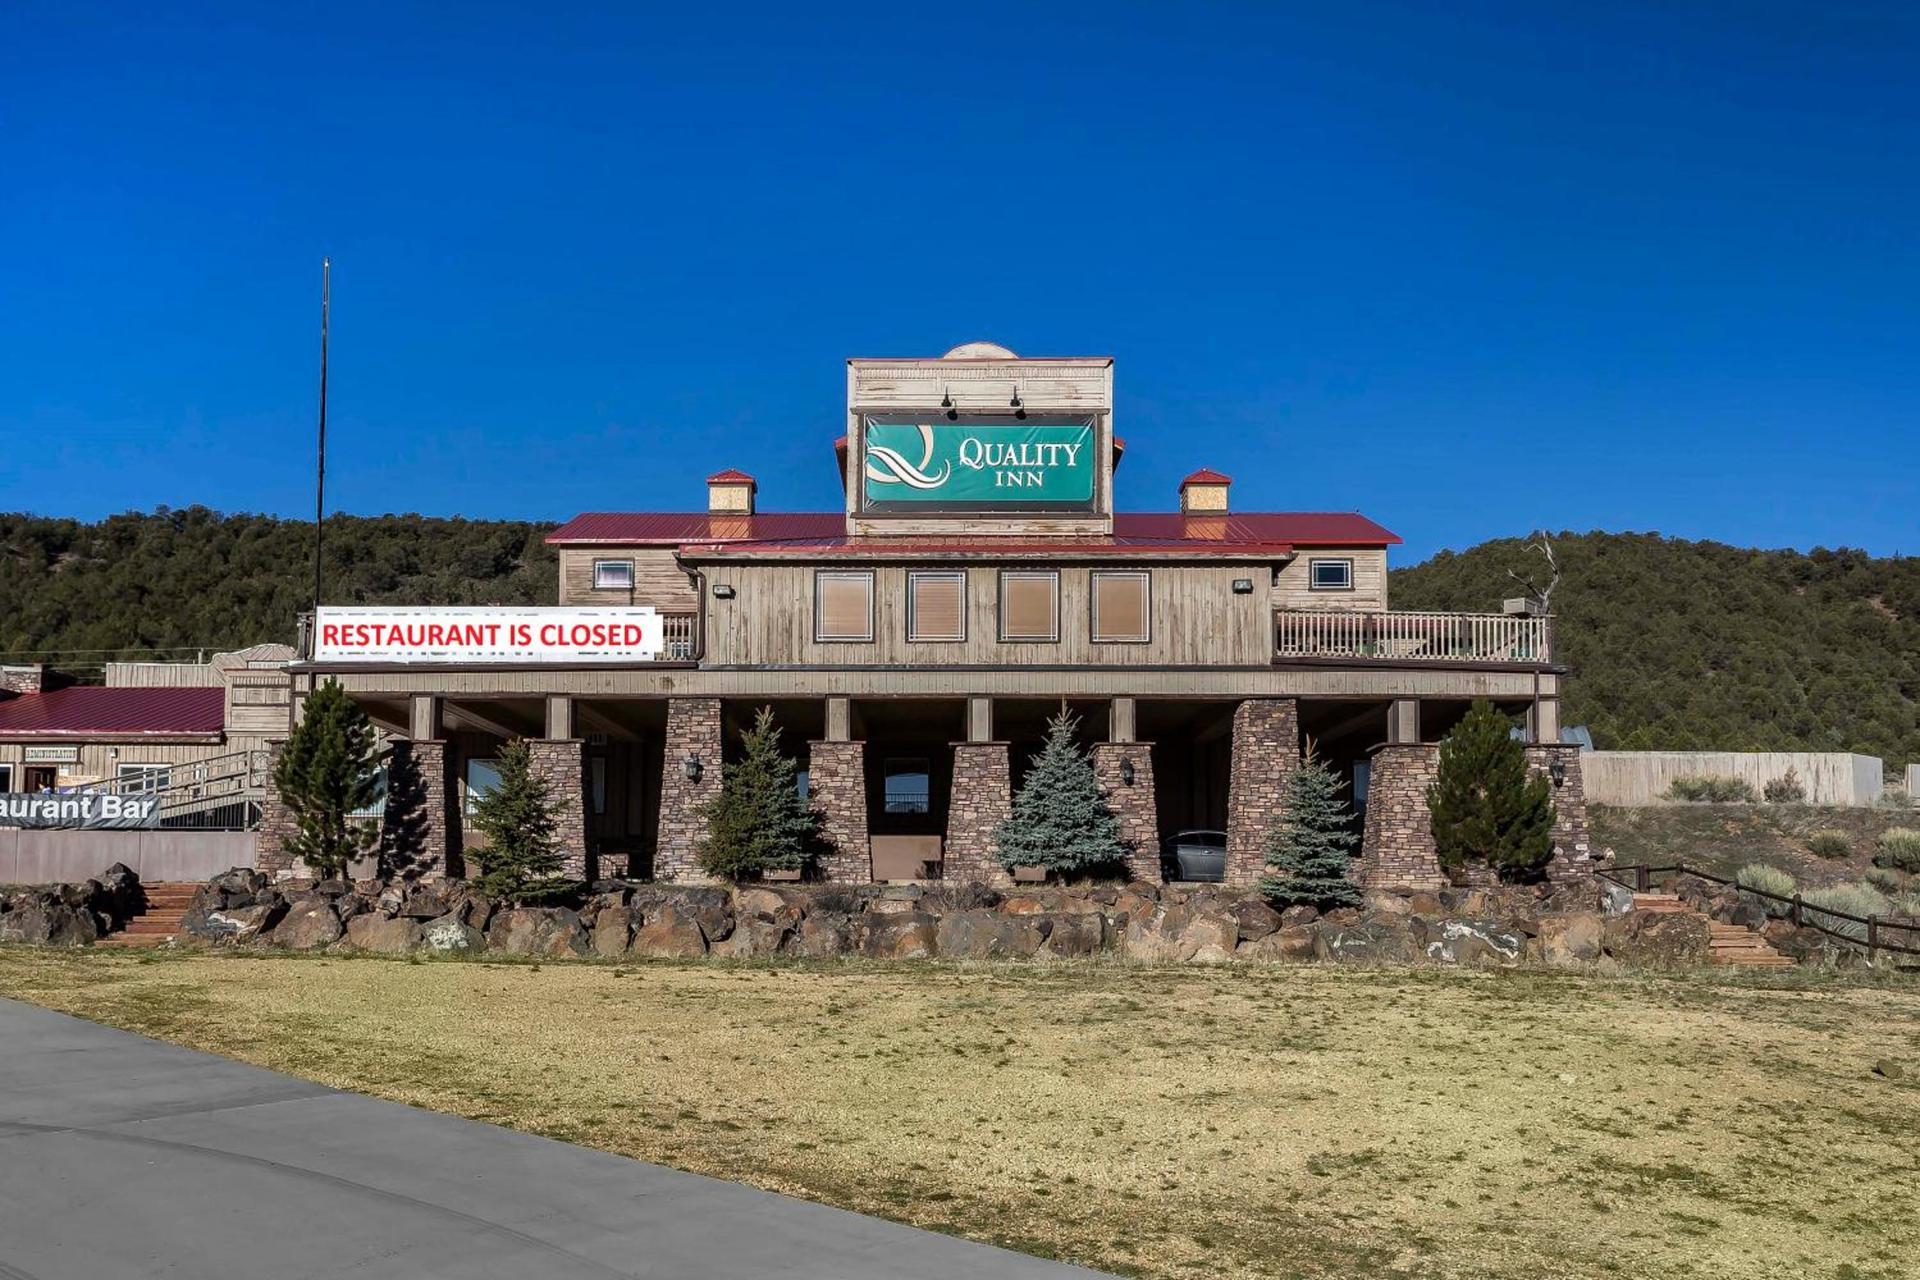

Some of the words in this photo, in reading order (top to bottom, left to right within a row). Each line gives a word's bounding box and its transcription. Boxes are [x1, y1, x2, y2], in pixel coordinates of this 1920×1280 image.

[959, 438, 1082, 470] QUALITY
[996, 472, 1044, 487] INN
[323, 624, 501, 646] RESTAURANT
[510, 624, 532, 646] IS
[540, 624, 642, 646] CLOSED
[101, 796, 153, 818] Bar
